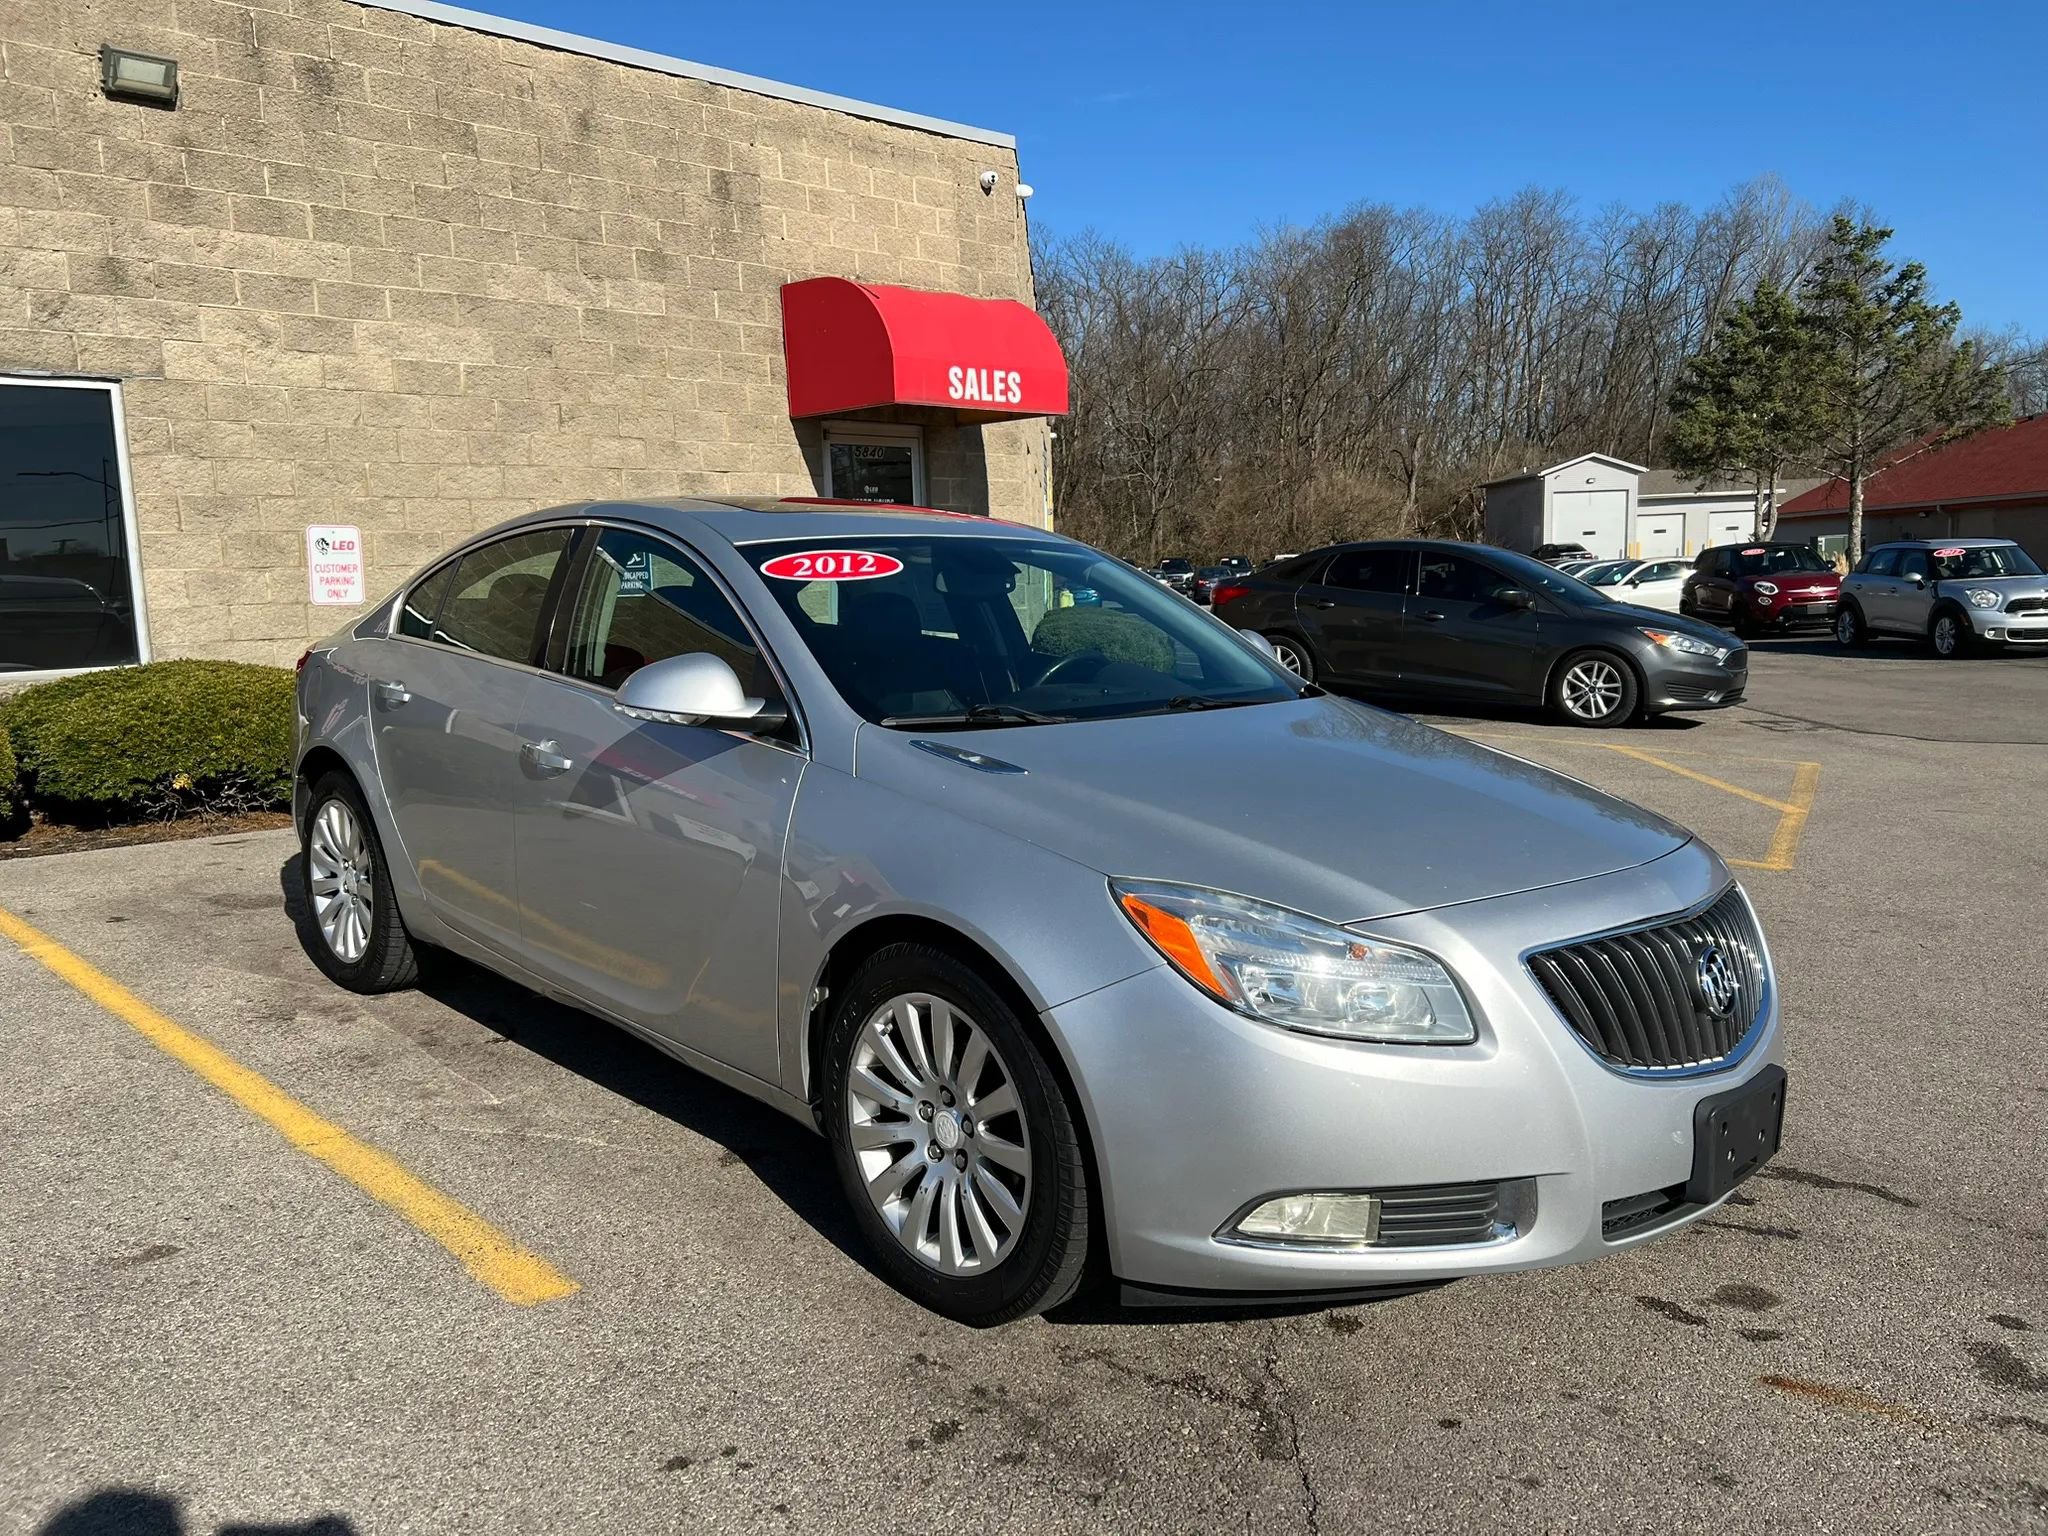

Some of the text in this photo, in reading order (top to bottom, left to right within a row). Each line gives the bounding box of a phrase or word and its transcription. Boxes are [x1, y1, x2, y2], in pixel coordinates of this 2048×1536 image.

[948, 365, 1022, 404] SALES
[331, 540, 355, 551] LEO
[314, 563, 358, 573] CUSTOMER
[792, 555, 877, 576] 2012
[319, 576, 355, 586] PARKING
[620, 581, 644, 590] PARKING
[326, 588, 348, 600] ONLY
